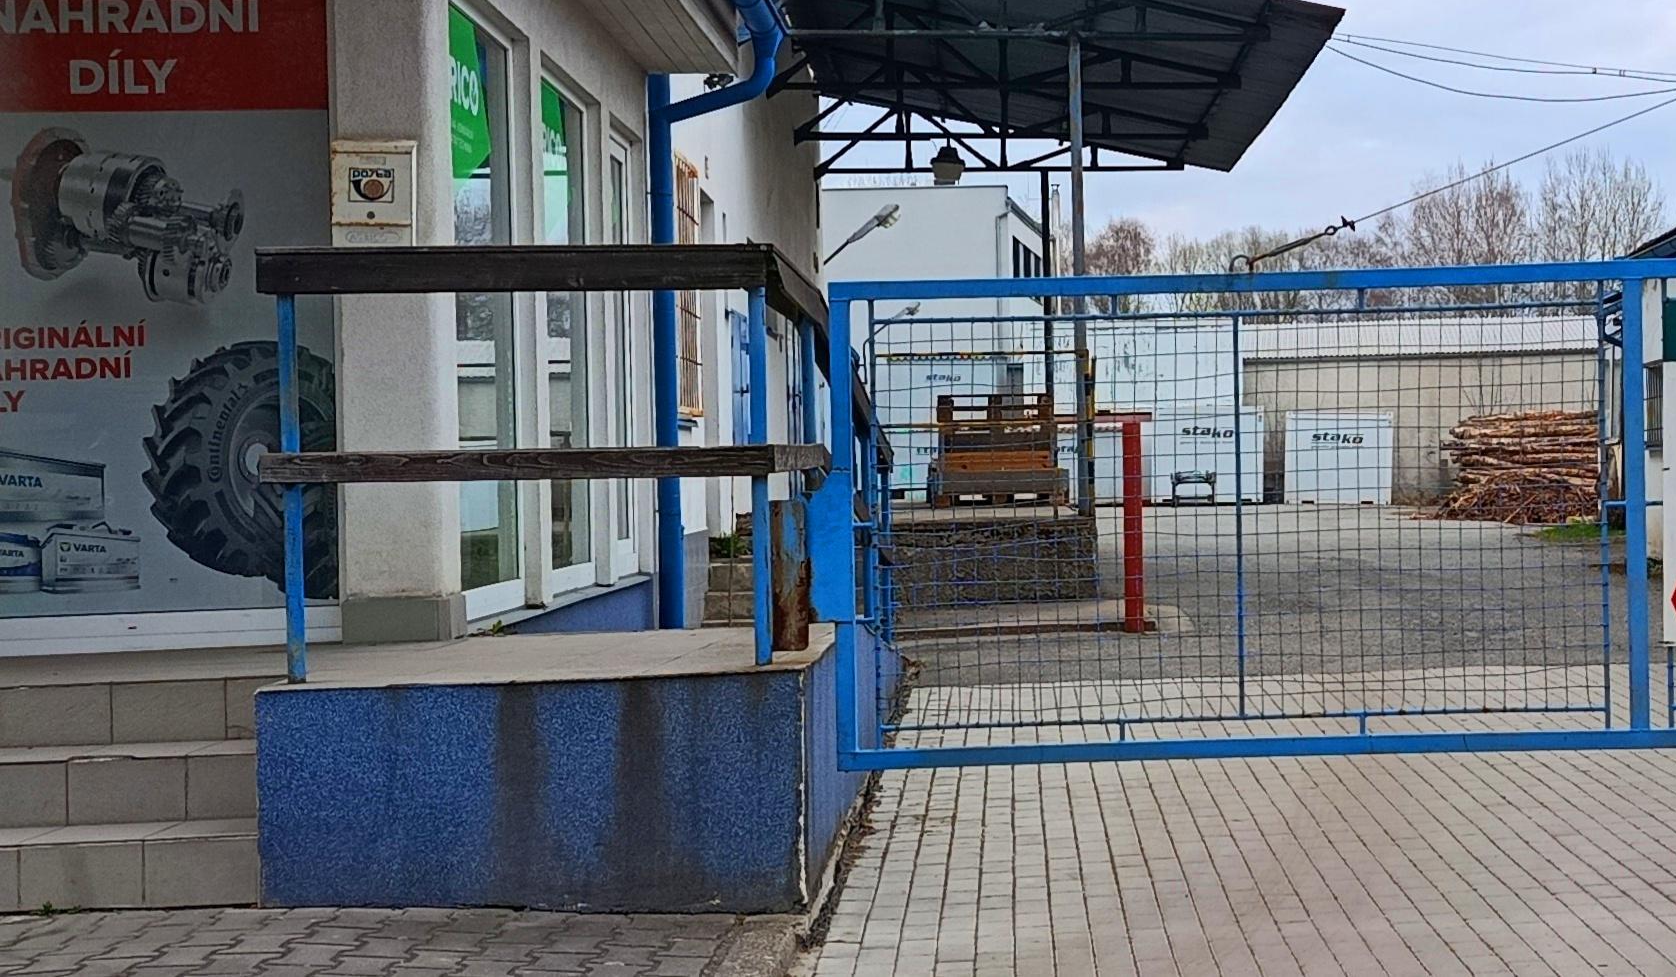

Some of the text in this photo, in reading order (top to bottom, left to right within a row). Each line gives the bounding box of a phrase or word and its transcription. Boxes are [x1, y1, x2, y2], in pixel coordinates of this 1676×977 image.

[69, 49, 177, 94] DÍLY
[0, 319, 146, 349] IGINÁLNÍ
[0, 350, 131, 381] HRADNÍ
[207, 390, 245, 483] Continental
[1181, 425, 1234, 438] stako
[1312, 432, 1363, 444] stako
[73, 543, 107, 554] VARTA
